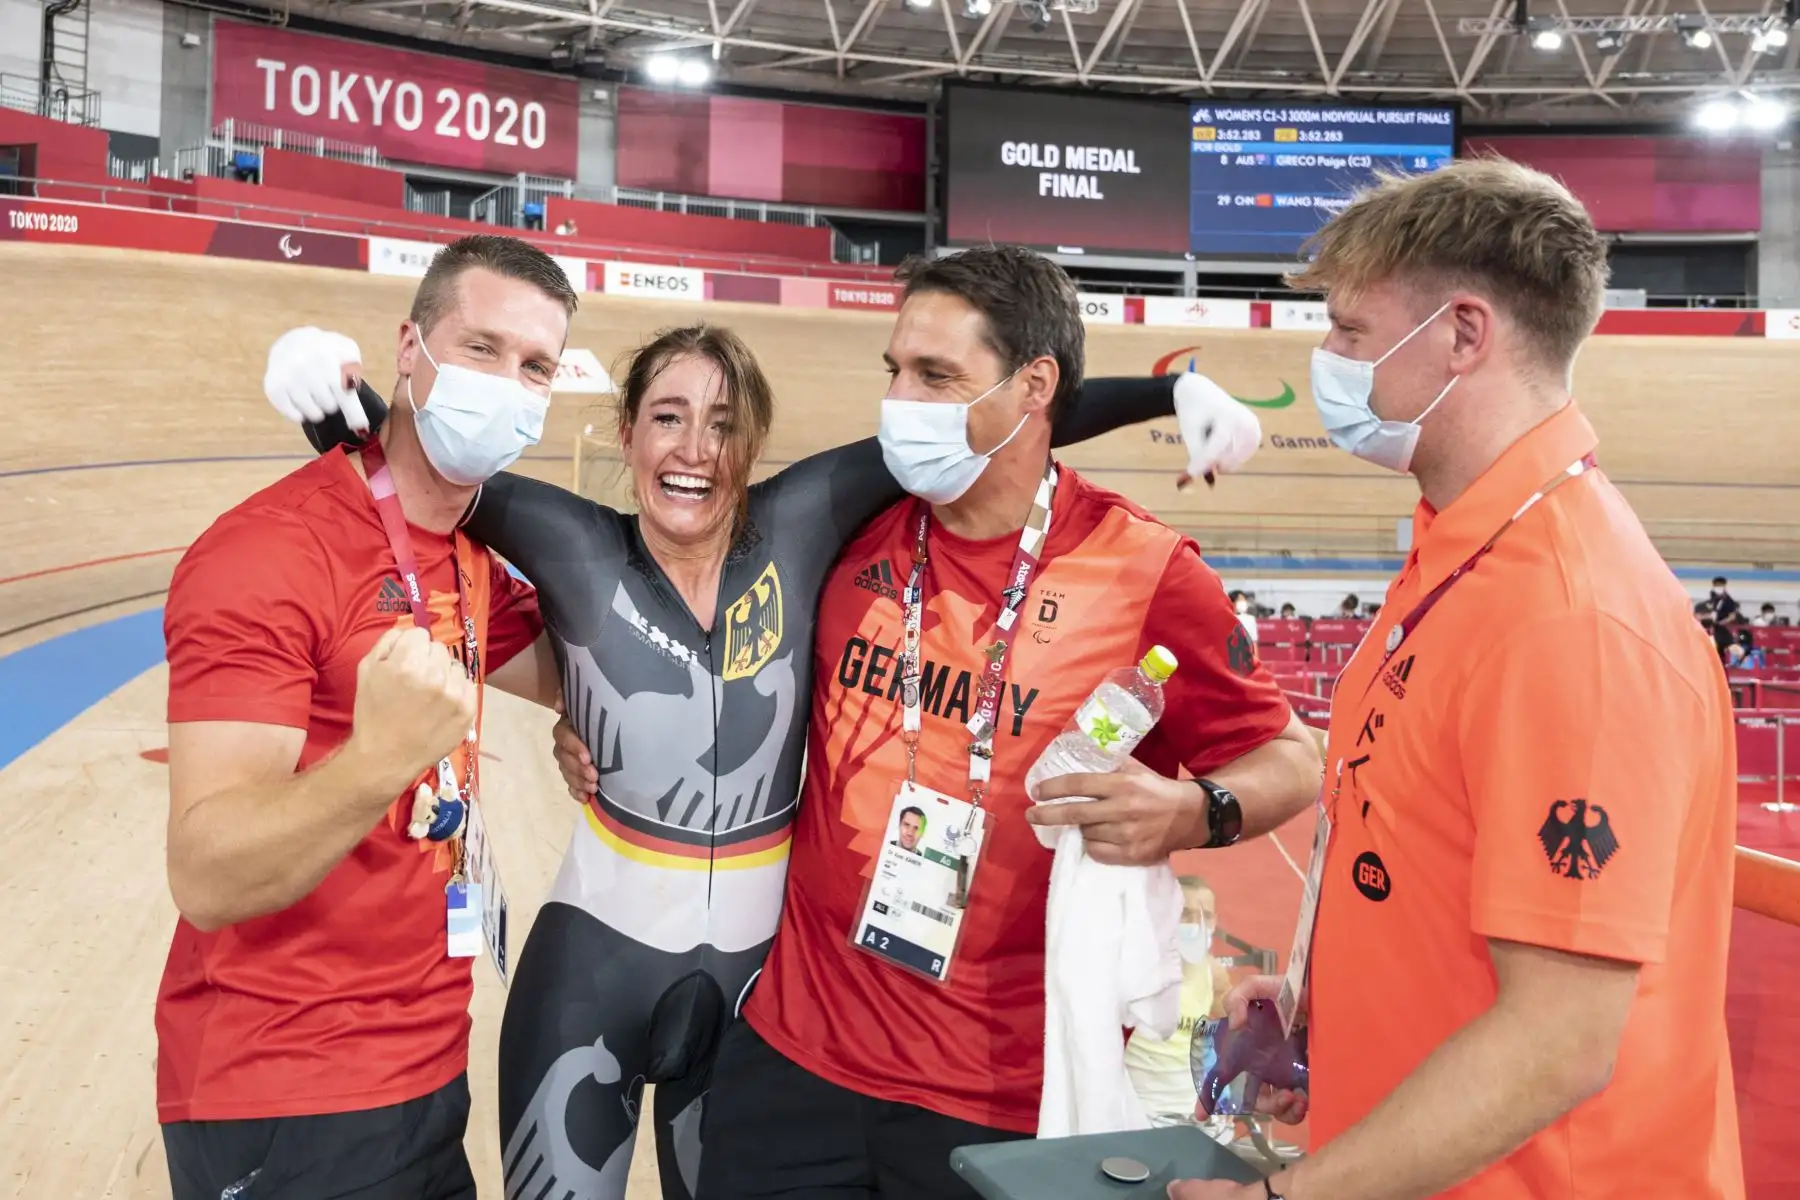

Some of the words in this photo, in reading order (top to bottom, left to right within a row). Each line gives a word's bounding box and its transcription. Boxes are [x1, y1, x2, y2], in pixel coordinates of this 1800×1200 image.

[256, 58, 423, 131] TOKYO
[435, 88, 547, 149] 2020
[1215, 109, 1262, 122] WOMEN'S
[1321, 111, 1376, 124] INDIVIDUAL
[1377, 111, 1416, 124] PURSUIT
[1417, 112, 1451, 125] FINALS
[1001, 141, 1060, 168] GOLD
[1065, 145, 1141, 174] MEDAL
[1235, 155, 1255, 165] AUS
[1276, 156, 1317, 167] GRECO
[1318, 156, 1346, 169] Paige
[1039, 172, 1104, 200] FINAL
[1217, 194, 1231, 206] 29
[1275, 195, 1312, 207] WANG
[8, 209, 48, 231] TOKYO
[49, 213, 78, 233] 2020
[633, 273, 690, 292] ENEOS
[834, 287, 867, 304] TOKYO
[868, 290, 895, 305] 2020
[855, 576, 898, 600] adidas
[1040, 589, 1066, 599] TEAM
[838, 636, 1040, 737] GERMAY
[1383, 671, 1406, 700] adidas
[1358, 861, 1386, 892] GER
[866, 931, 875, 944] A
[880, 936, 889, 949] 2
[931, 958, 941, 972] R
